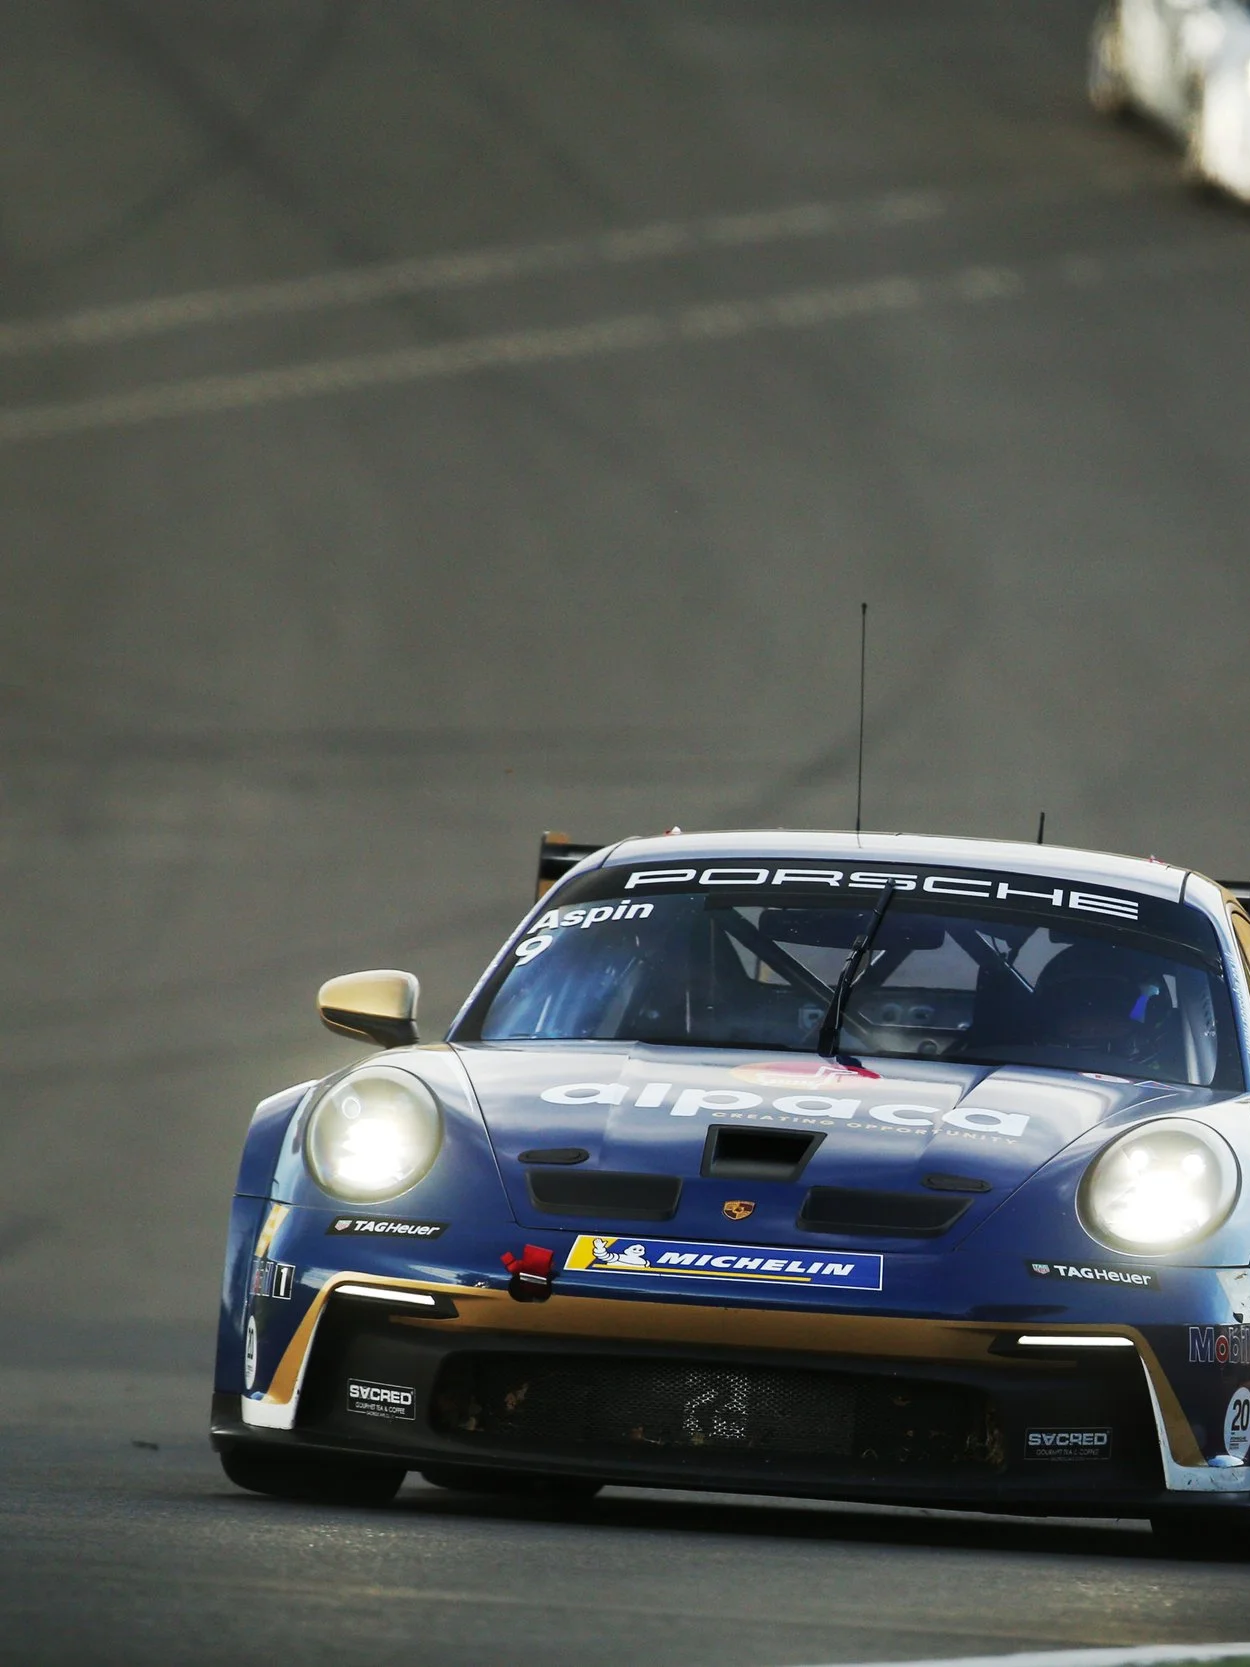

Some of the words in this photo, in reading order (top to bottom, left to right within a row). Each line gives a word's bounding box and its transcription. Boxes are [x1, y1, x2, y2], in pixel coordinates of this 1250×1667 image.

[624, 868, 1139, 920] PORSCHE
[526, 900, 655, 935] Aspin
[515, 935, 554, 966] 9
[540, 1082, 1031, 1137] alpaca
[711, 1111, 835, 1127] CREATING
[846, 1121, 1018, 1146] OPPORTUNITY
[656, 1251, 856, 1277] MICHELIN
[1188, 1325, 1250, 1364] Mobil
[349, 1384, 413, 1406] SACRED
[1231, 1398, 1250, 1431] 20
[1028, 1432, 1108, 1446] SACRED
